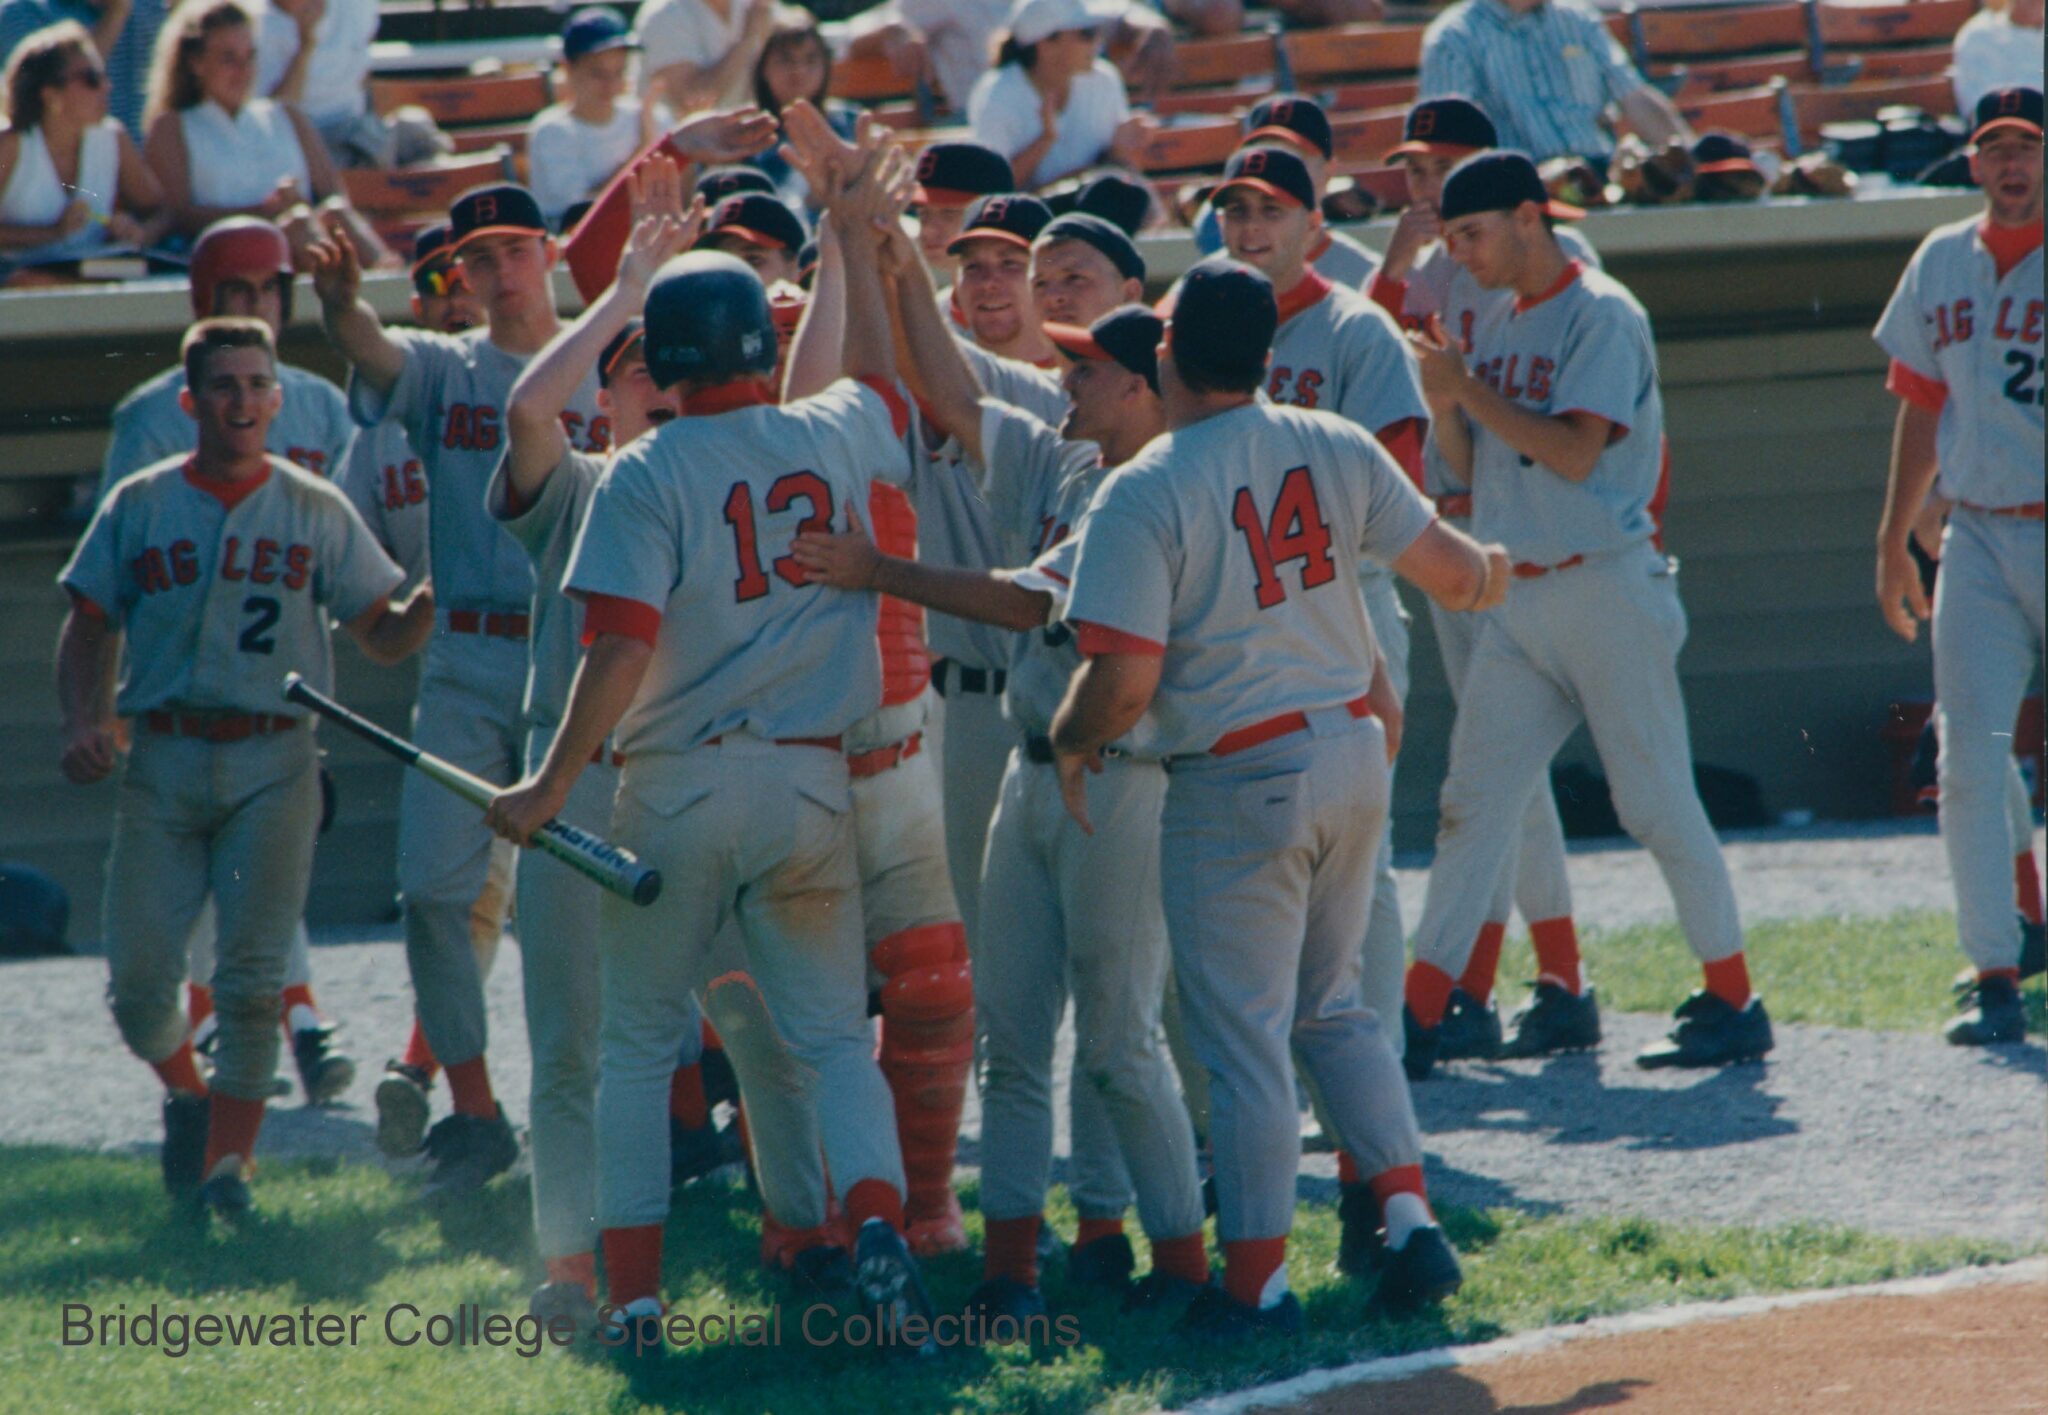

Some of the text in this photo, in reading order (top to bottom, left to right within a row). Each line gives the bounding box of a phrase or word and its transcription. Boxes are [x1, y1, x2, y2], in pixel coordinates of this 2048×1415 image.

[1413, 109, 1436, 136] B
[474, 195, 498, 224] B
[2003, 349, 2044, 406] 2
[723, 470, 834, 604] 13
[1232, 465, 1336, 610] 14
[238, 596, 281, 654] 2
